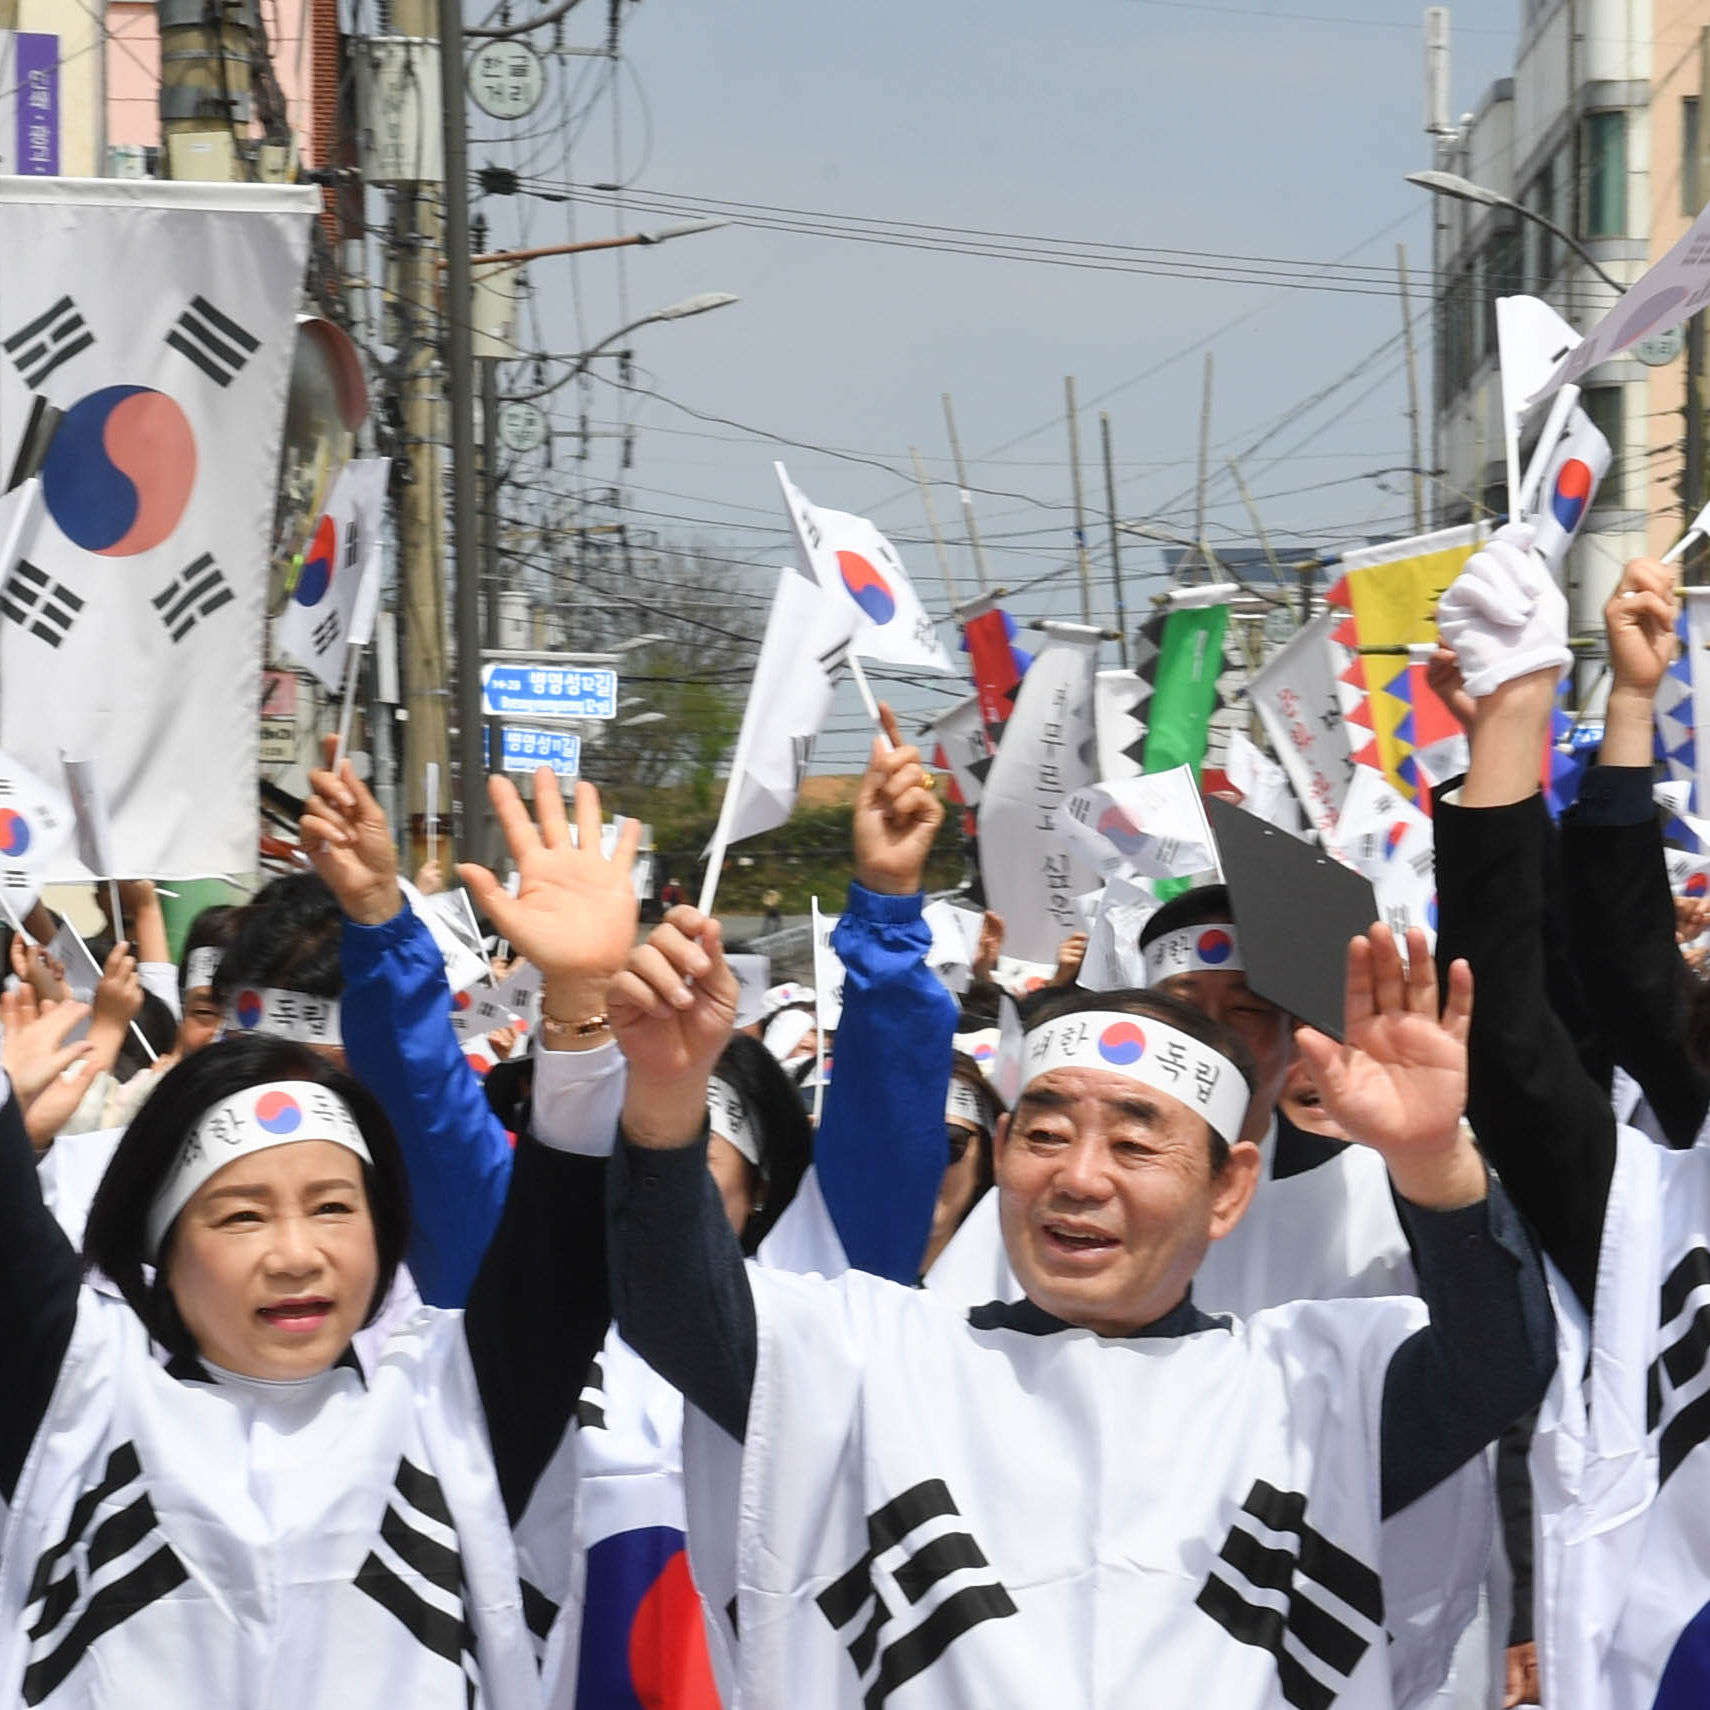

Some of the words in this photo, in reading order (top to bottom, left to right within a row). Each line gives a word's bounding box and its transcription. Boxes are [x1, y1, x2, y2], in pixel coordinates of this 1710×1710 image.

[269, 999, 331, 1037] 독립
[1029, 1022, 1091, 1063] 대한
[1154, 1041, 1221, 1105] 독립
